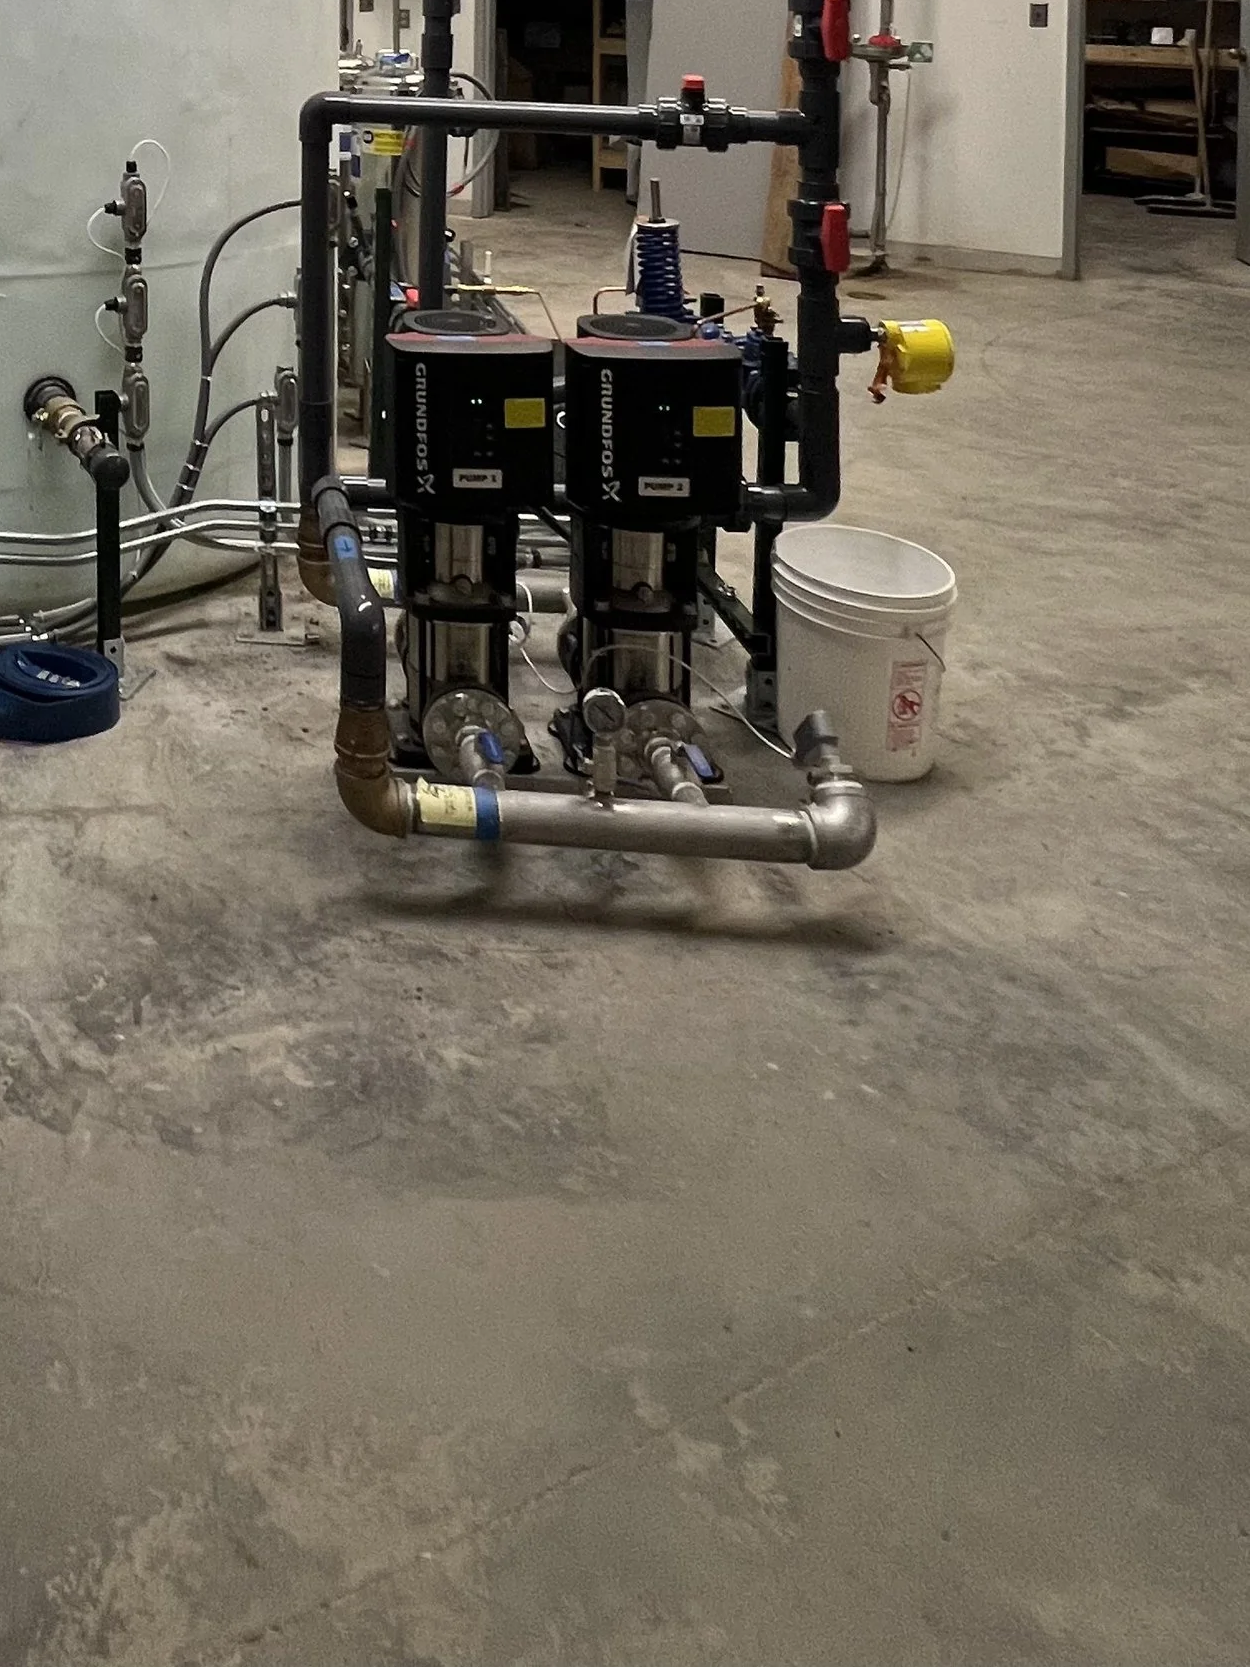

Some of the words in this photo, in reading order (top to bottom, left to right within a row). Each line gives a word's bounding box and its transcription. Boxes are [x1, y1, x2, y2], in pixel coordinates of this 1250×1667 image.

[415, 362, 428, 471] GRUNDFOS
[601, 368, 613, 478] GRUNDFOS
[459, 474, 488, 482] PUMP
[644, 482, 673, 491] PUMP
[677, 483, 683, 491] 2
